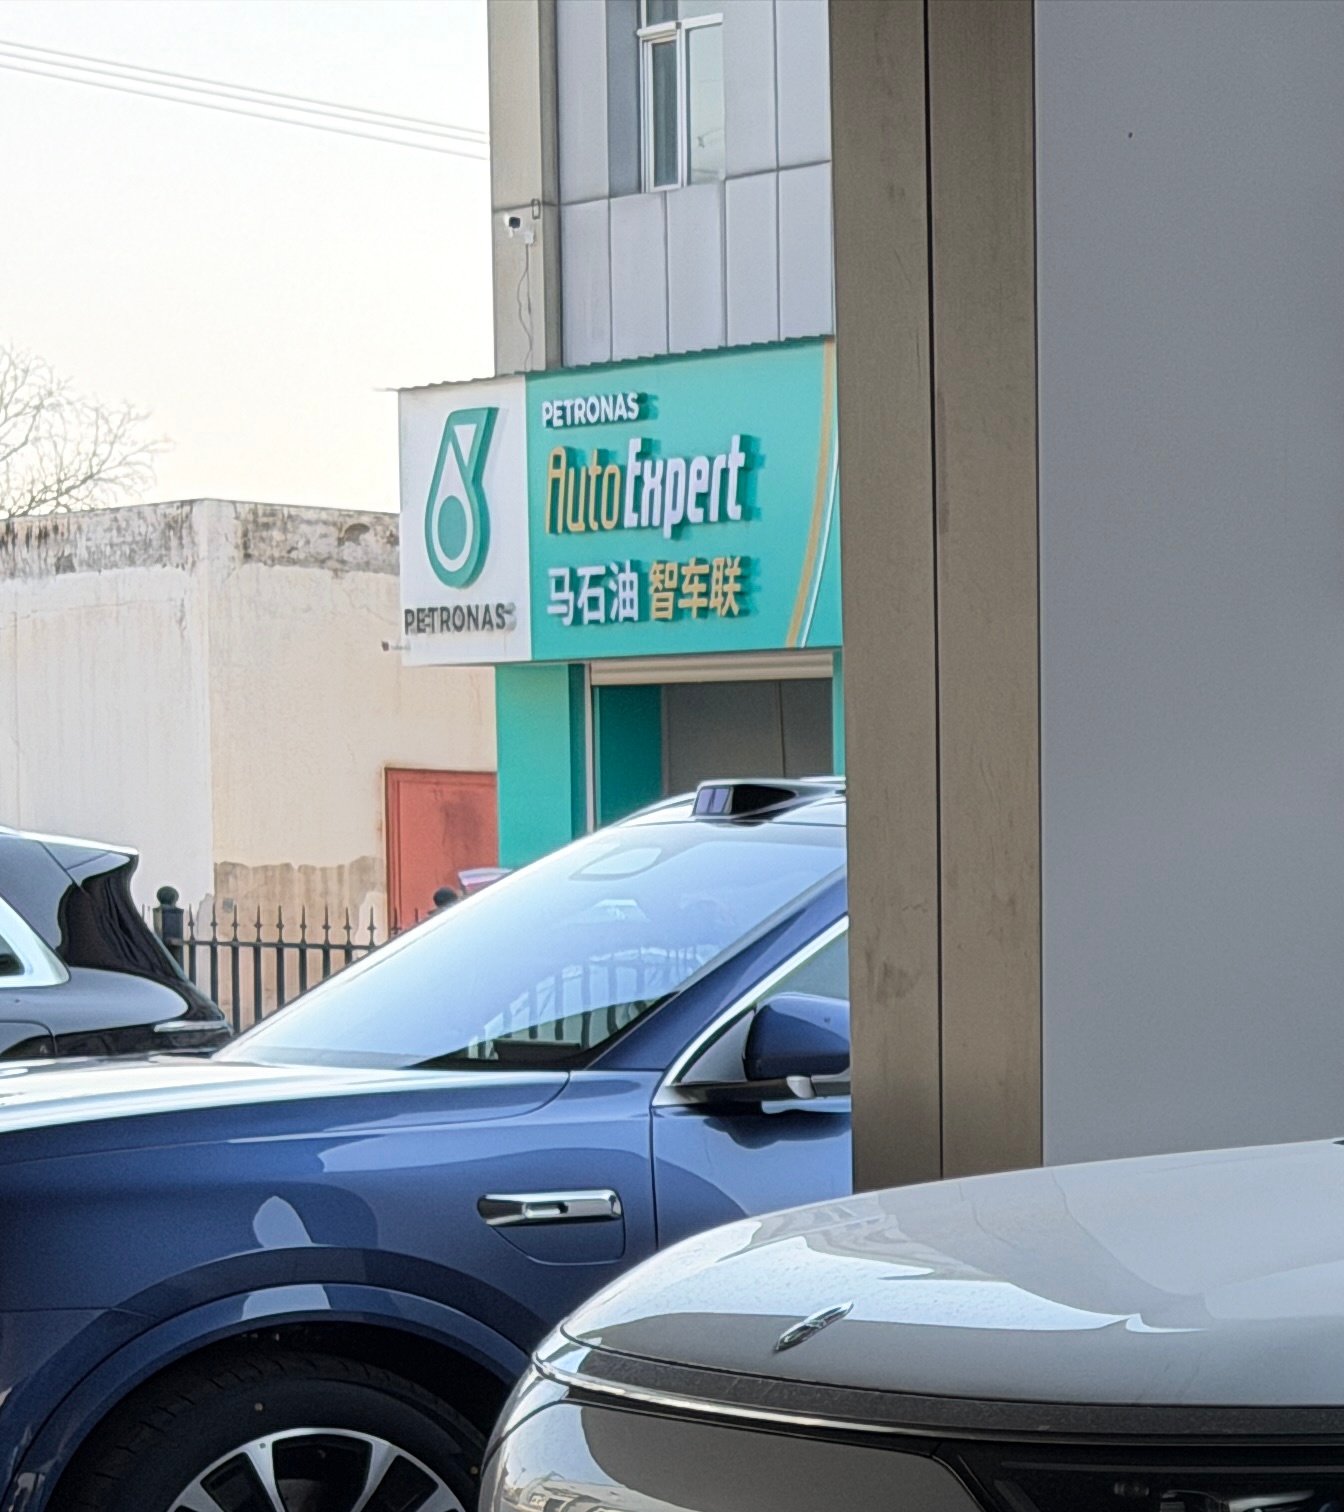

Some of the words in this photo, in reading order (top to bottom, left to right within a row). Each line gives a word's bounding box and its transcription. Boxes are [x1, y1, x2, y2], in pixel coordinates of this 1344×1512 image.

[541, 392, 640, 428] PETRONAS
[545, 434, 746, 539] AutoExpert
[404, 603, 508, 635] PETRONAS
